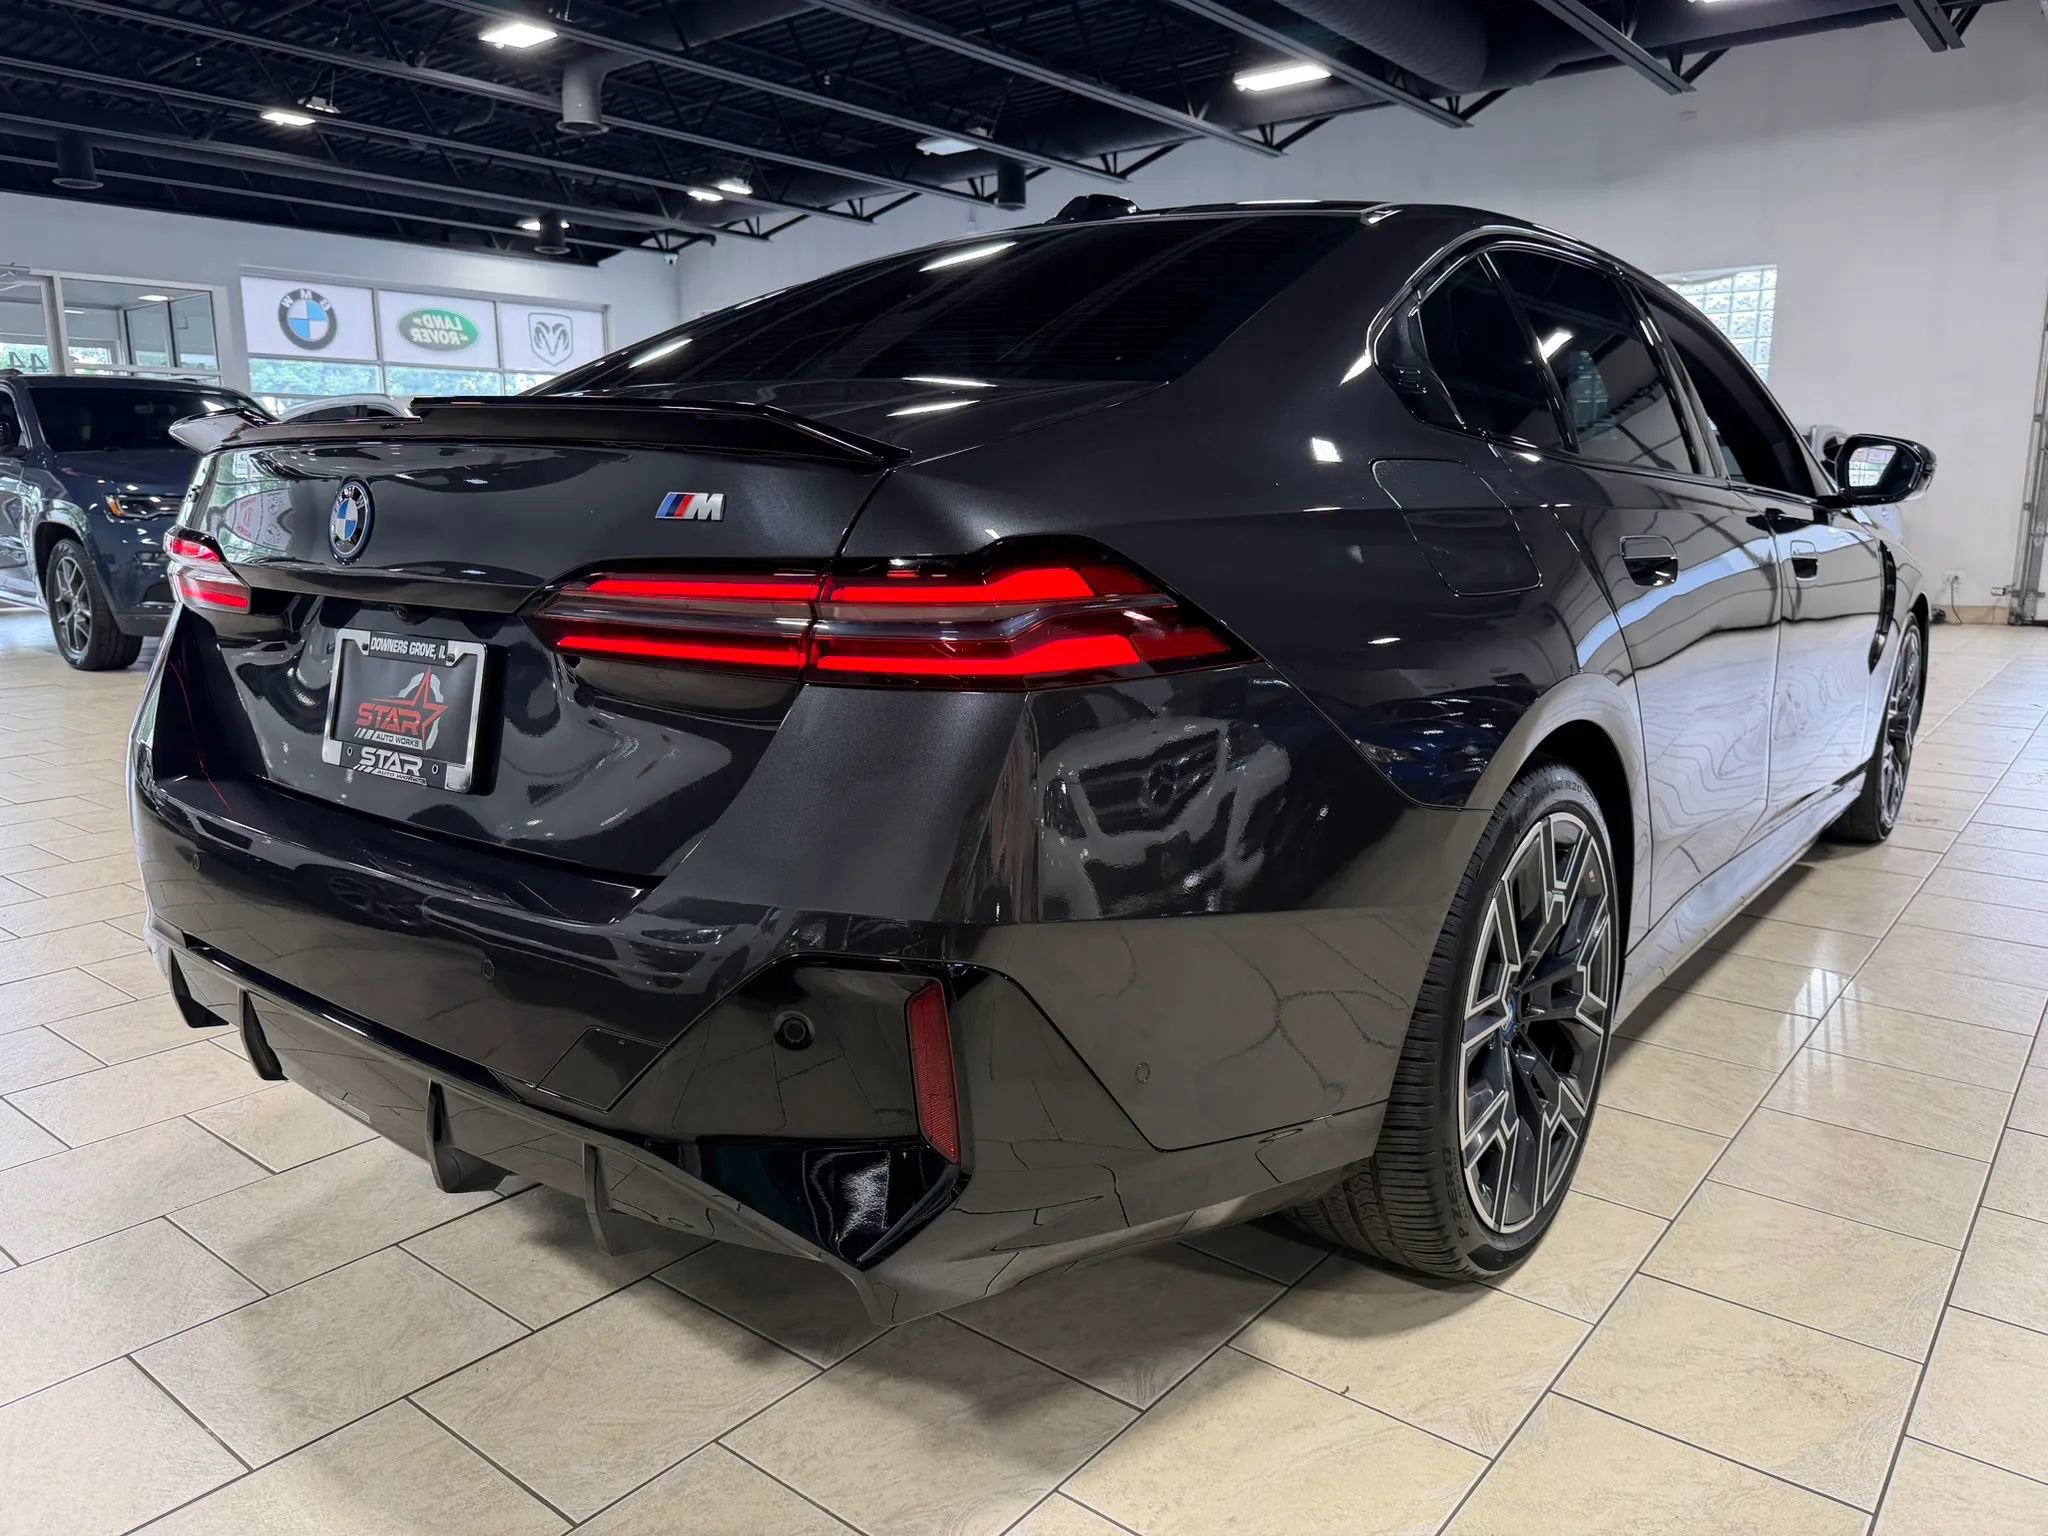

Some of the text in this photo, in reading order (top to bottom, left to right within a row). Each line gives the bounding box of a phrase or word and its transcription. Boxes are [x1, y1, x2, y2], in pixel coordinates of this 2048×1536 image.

[370, 636, 447, 661] DOWNERS GROVE, IL
[355, 702, 423, 736] STAR
[376, 733, 420, 748] AUTO WORKS
[359, 746, 423, 777] STAR
[376, 770, 395, 778] AUTO
